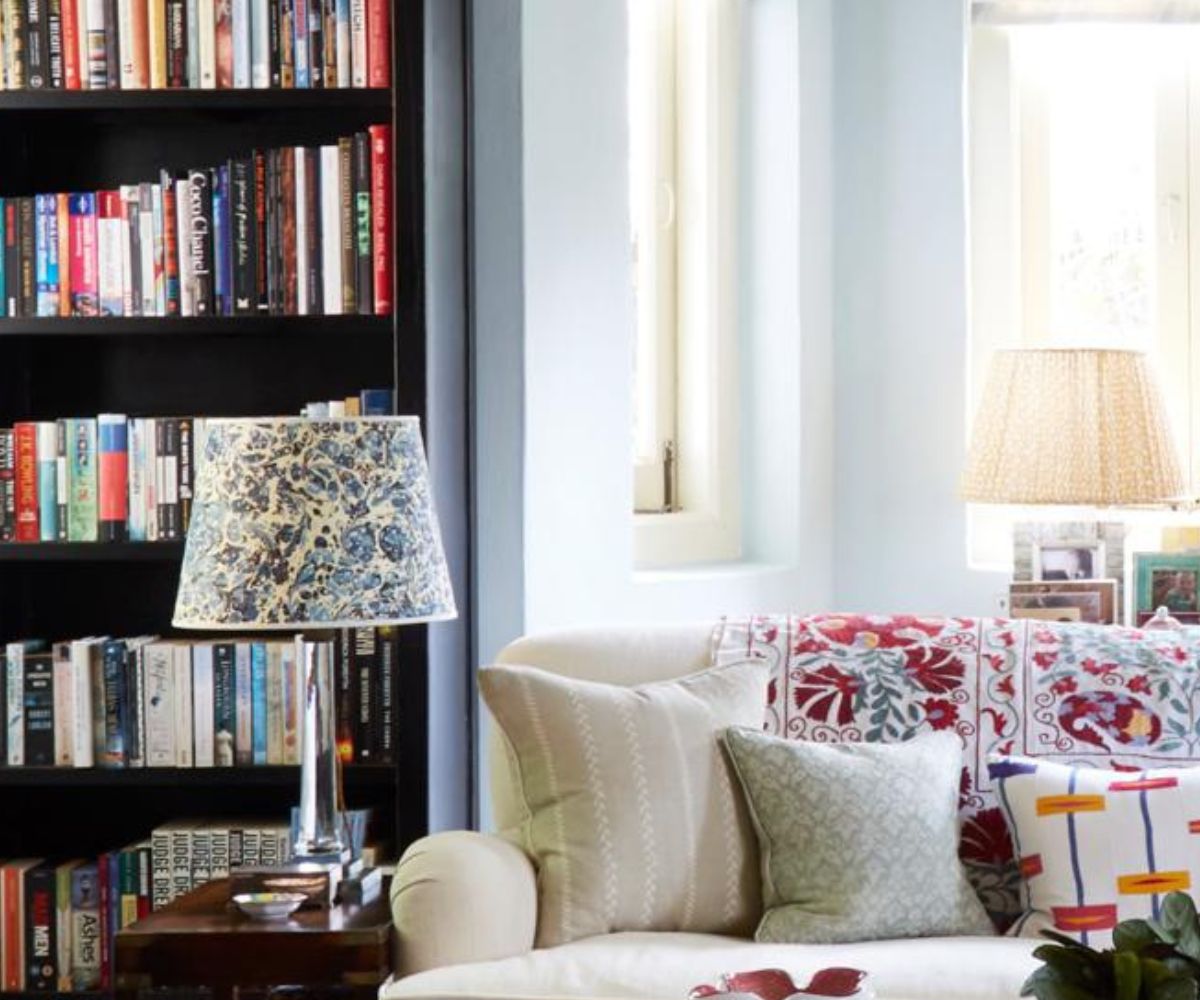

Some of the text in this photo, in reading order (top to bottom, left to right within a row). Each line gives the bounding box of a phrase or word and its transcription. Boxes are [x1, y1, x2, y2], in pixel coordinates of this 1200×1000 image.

[190, 171, 209, 275] Coco Chanel
[153, 836, 169, 874] JUDGE
[173, 833, 188, 873] JUDGE
[193, 834, 209, 873] JUDGE
[212, 834, 227, 873] JUDGE
[81, 915, 97, 963] Ashes
